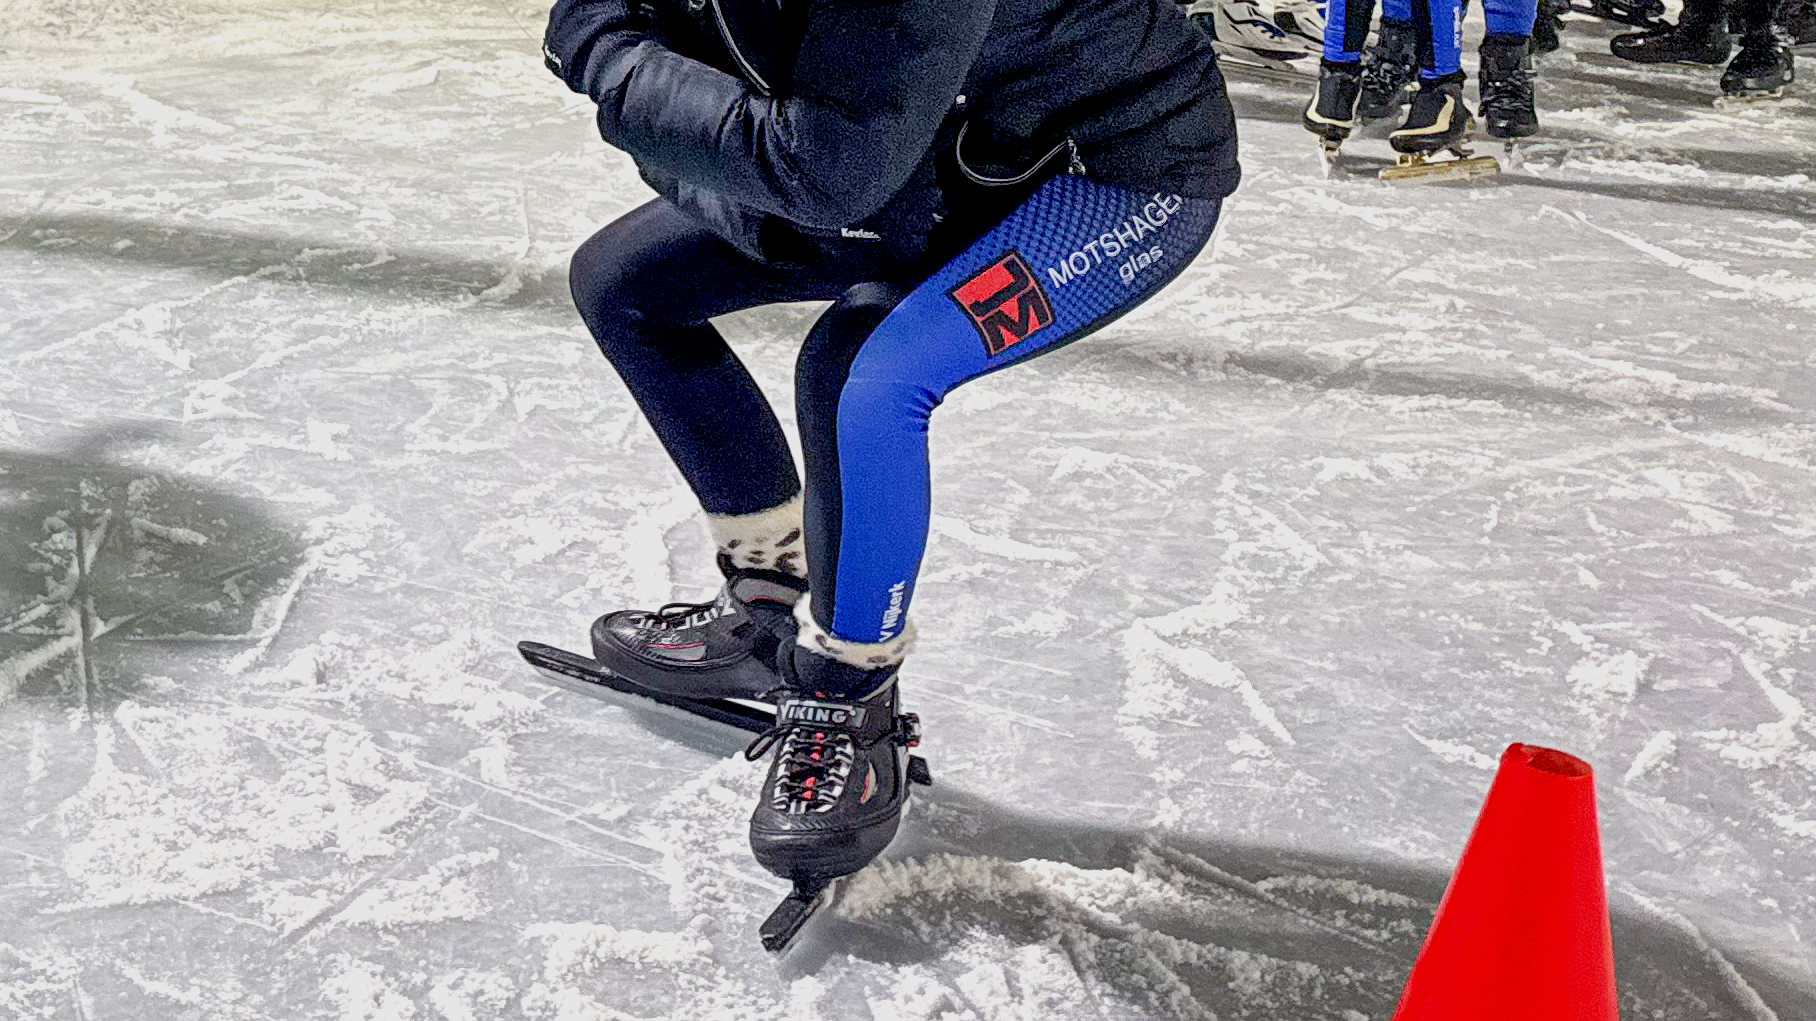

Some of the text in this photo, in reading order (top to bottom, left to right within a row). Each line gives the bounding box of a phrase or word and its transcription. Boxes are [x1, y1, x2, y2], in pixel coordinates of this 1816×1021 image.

[1047, 191, 1183, 289] MOTSHAGE
[1118, 244, 1165, 287] glas
[780, 699, 848, 725] VIKING
